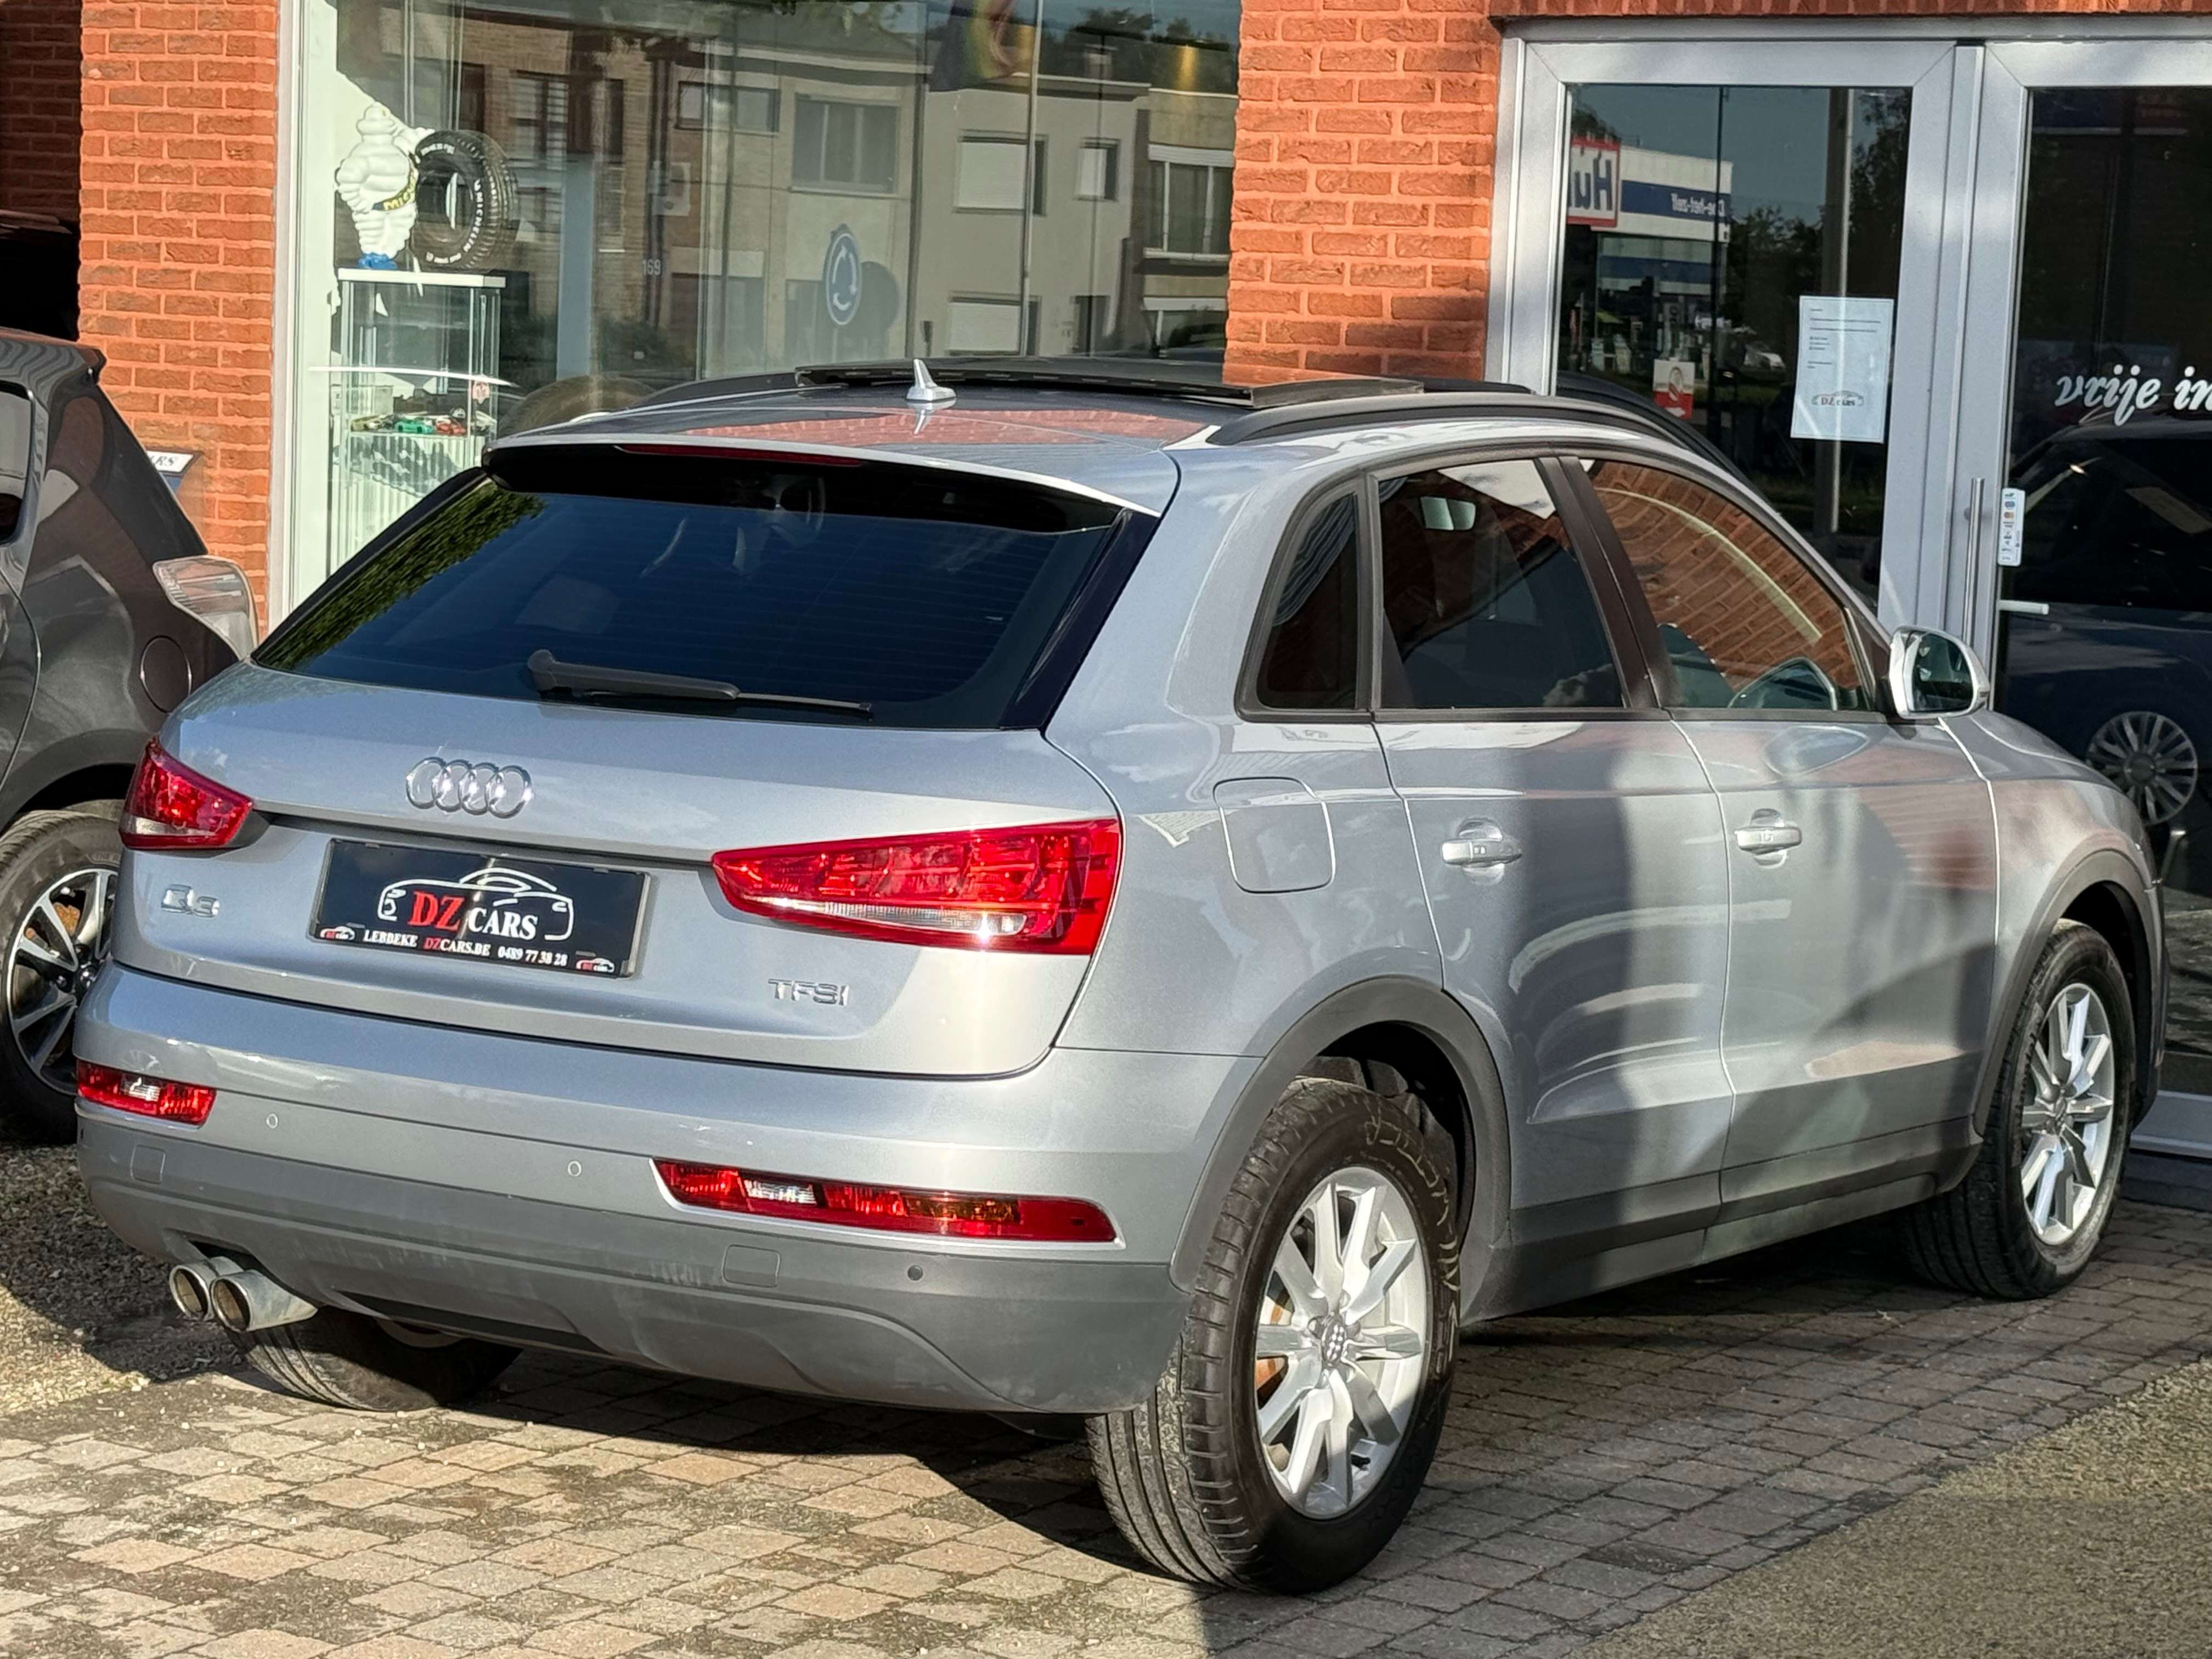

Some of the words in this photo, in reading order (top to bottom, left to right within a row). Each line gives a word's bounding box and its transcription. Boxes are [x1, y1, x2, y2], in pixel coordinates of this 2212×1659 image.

[642, 258, 661, 276] 169
[2055, 364, 2161, 426] vrije
[161, 884, 219, 918] Q3
[408, 890, 465, 931] DZ
[468, 907, 539, 940] CARS
[768, 978, 850, 1006] TFSI
